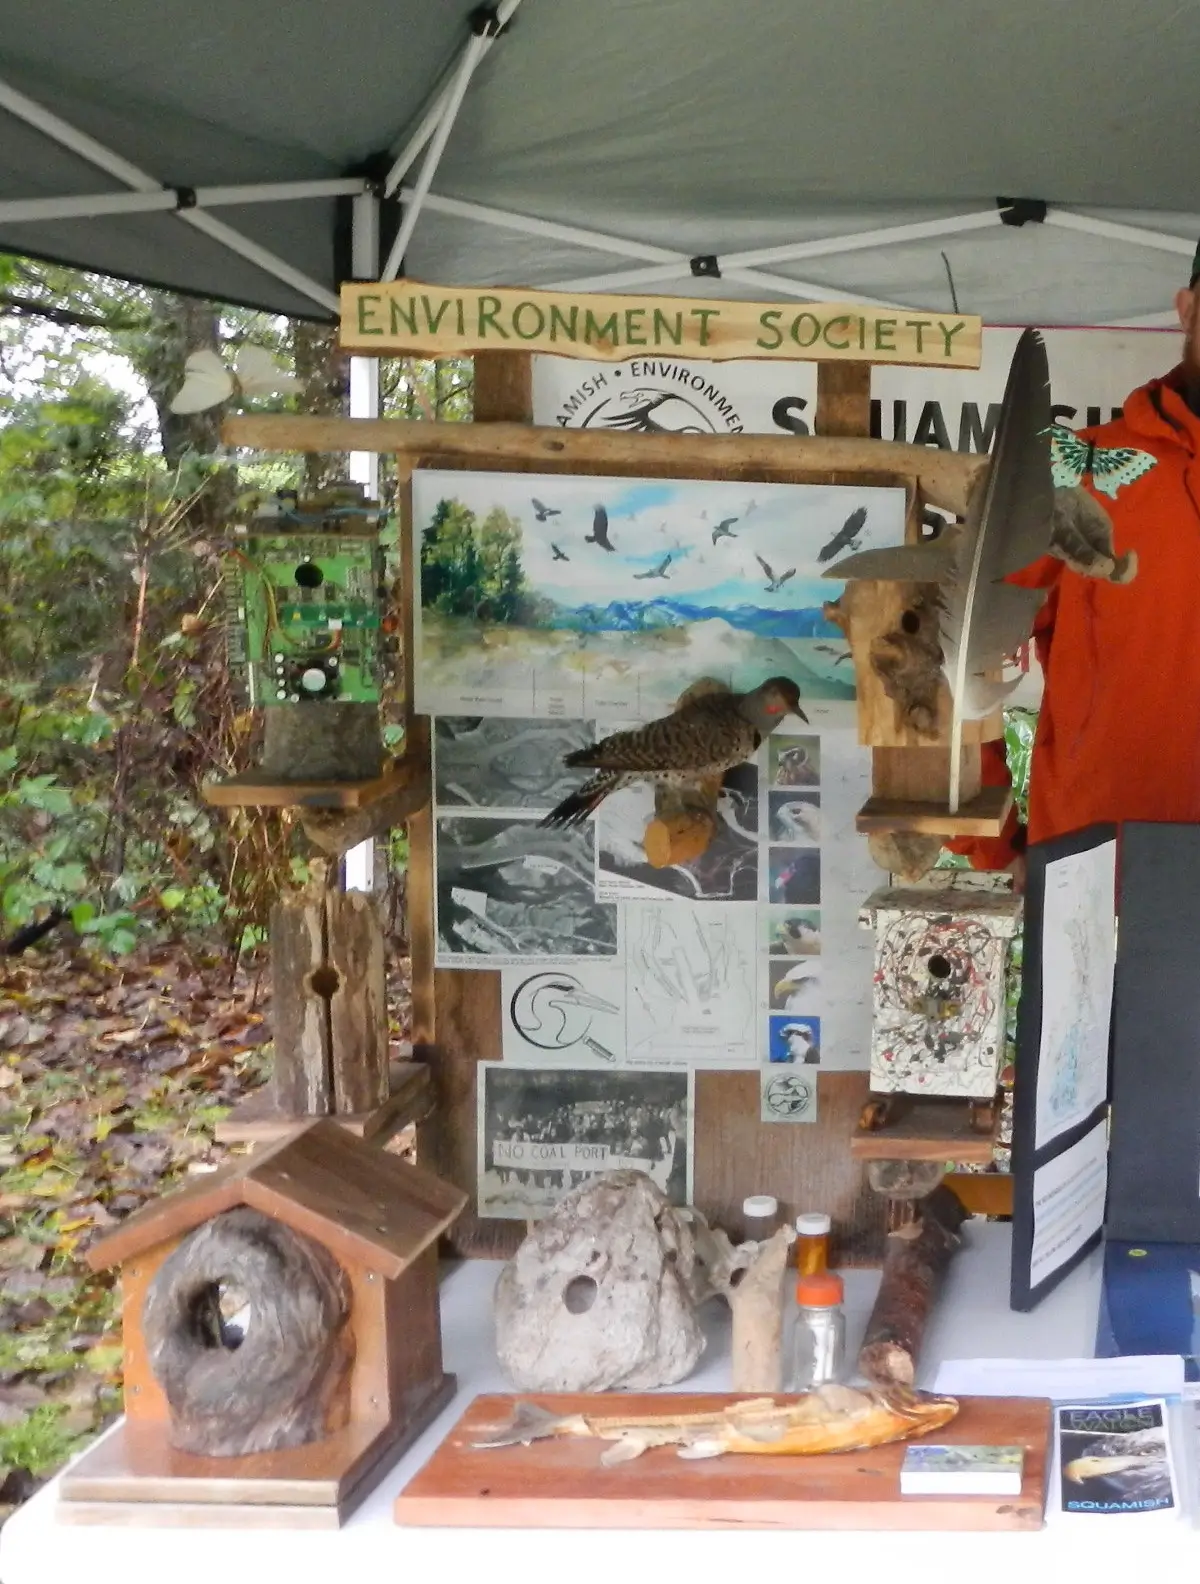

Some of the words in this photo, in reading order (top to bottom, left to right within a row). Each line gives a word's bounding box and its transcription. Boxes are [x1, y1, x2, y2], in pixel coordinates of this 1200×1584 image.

[357, 294, 721, 347] ENVIRONMENT
[756, 310, 966, 357] SOCIETY
[498, 1143, 525, 1160] NO
[530, 1144, 565, 1160] COAL
[575, 1145, 606, 1161] PORT
[1070, 1407, 1154, 1422] EAGLE
[1067, 1497, 1170, 1510] SQUAMISH
